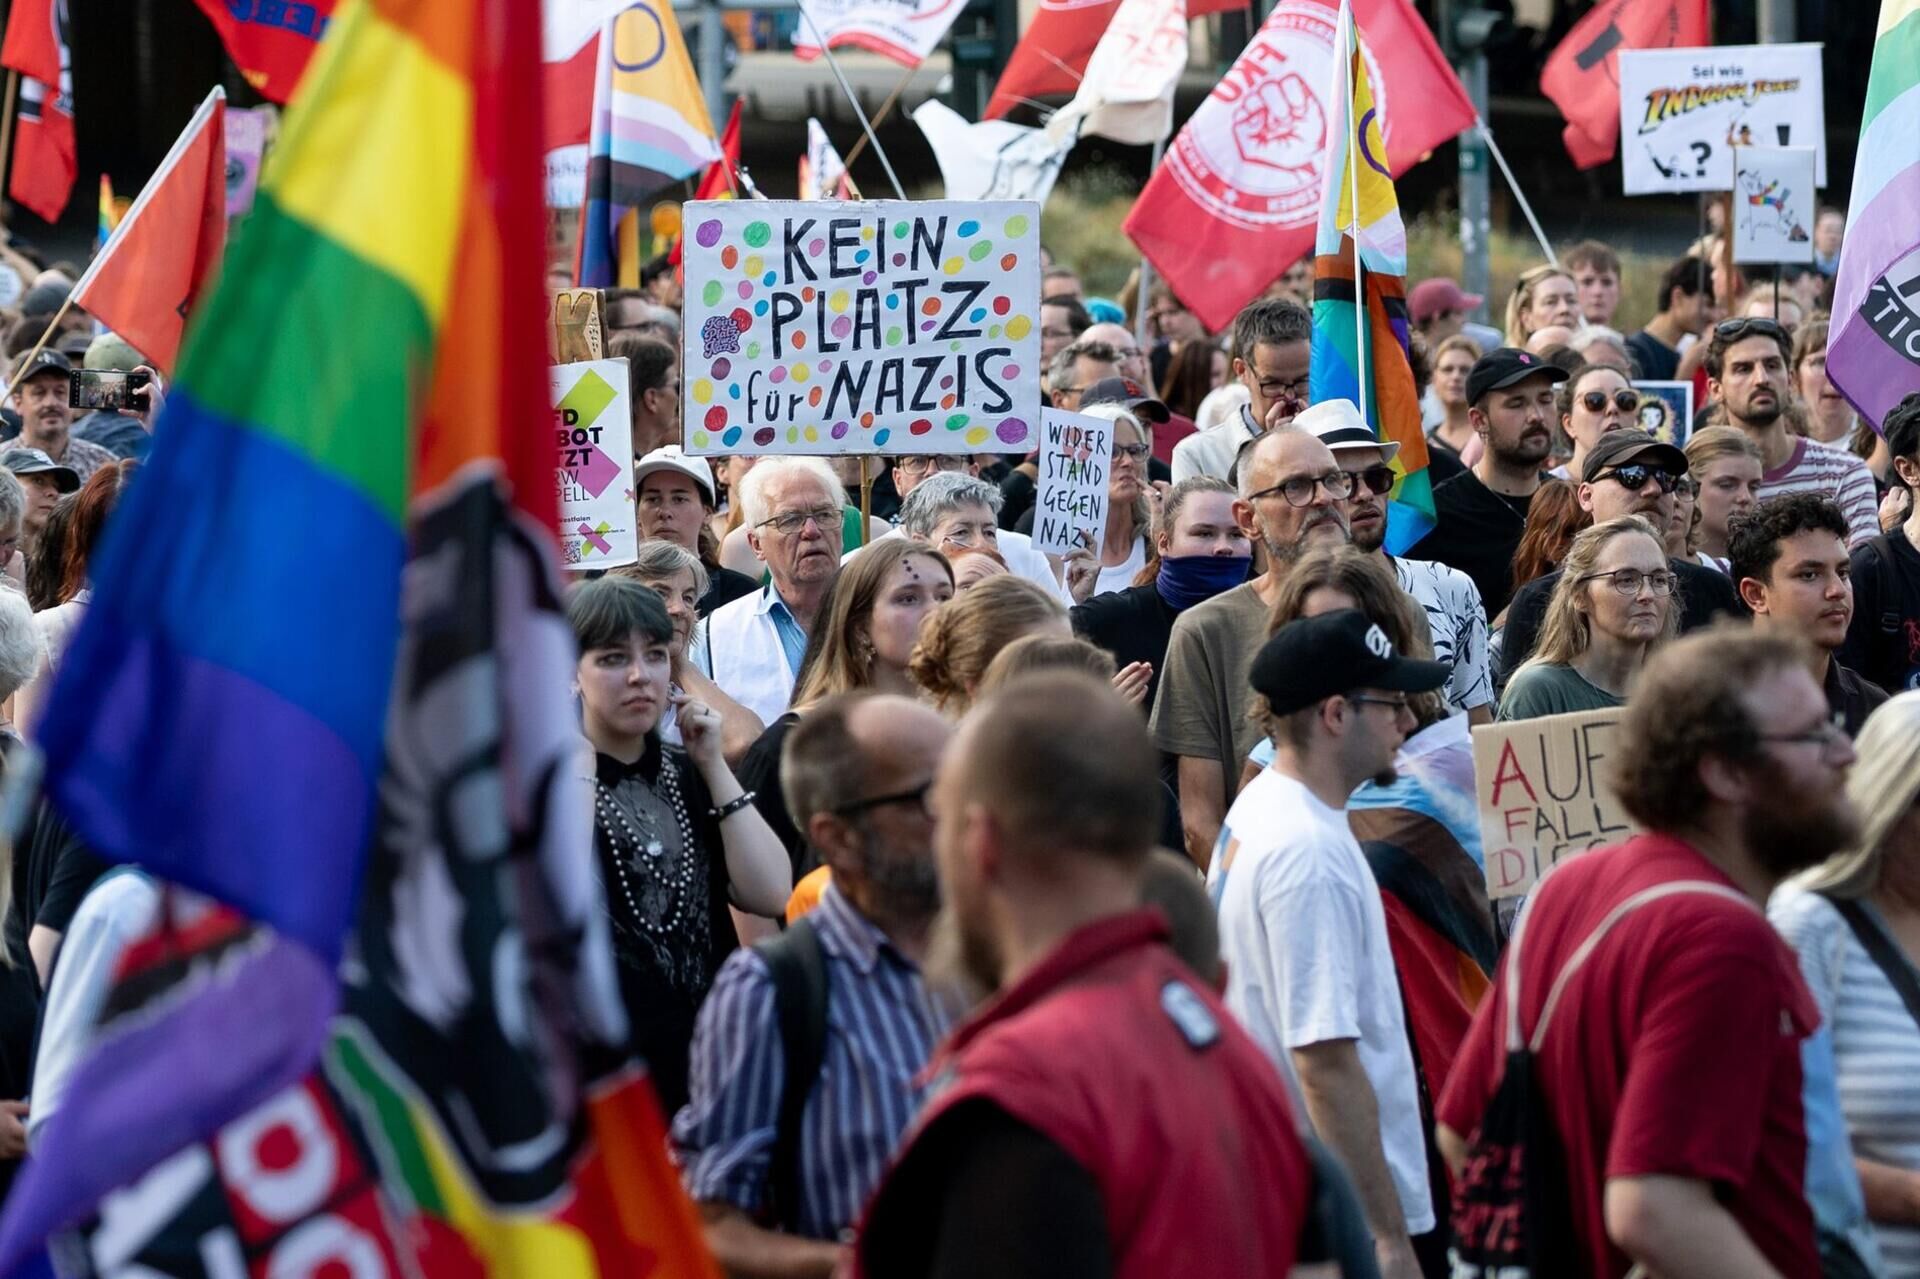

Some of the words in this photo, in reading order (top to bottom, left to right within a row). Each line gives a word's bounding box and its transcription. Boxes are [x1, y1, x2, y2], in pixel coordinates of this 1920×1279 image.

[1720, 66, 1744, 78] wie
[783, 215, 948, 285] KEIN
[771, 278, 990, 360] PLATZ
[747, 370, 804, 424] für
[821, 347, 1014, 421] NAZIS
[1048, 422, 1106, 456] WIDER
[1047, 451, 1102, 488] STAND
[1043, 485, 1101, 521] GEGEN
[1039, 517, 1099, 549] NAZ
[1491, 721, 1619, 807] AUF
[1504, 803, 1629, 843] FALL
